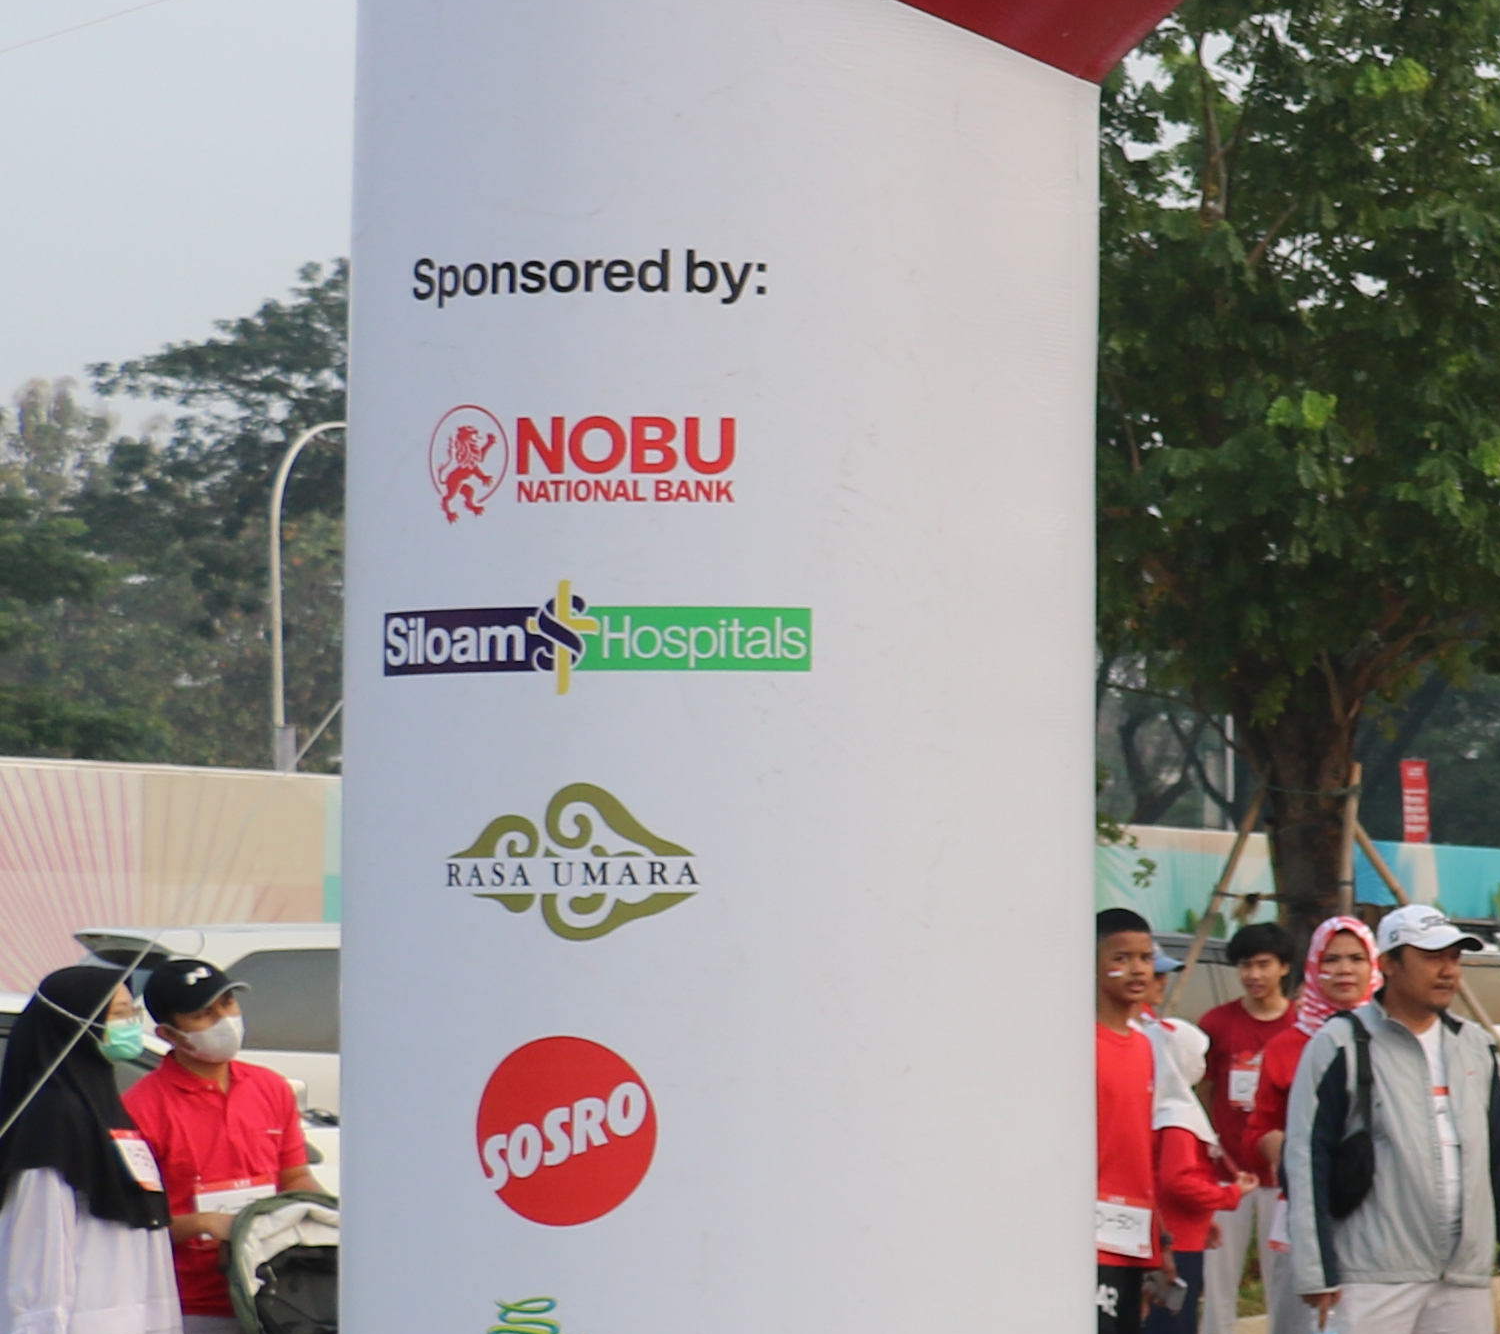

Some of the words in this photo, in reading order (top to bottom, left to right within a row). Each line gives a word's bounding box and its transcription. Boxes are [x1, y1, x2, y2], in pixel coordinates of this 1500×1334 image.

[412, 249, 671, 308] Sponsored
[685, 249, 768, 304] by:
[515, 415, 737, 475] NOBU
[516, 479, 646, 504] NATIONAL
[653, 479, 736, 504] BANK
[384, 617, 526, 666] Siloam
[601, 615, 807, 668] Hospitals
[446, 861, 533, 888] RASA
[551, 861, 701, 887] UMARA
[482, 1081, 648, 1192] SOSRO
